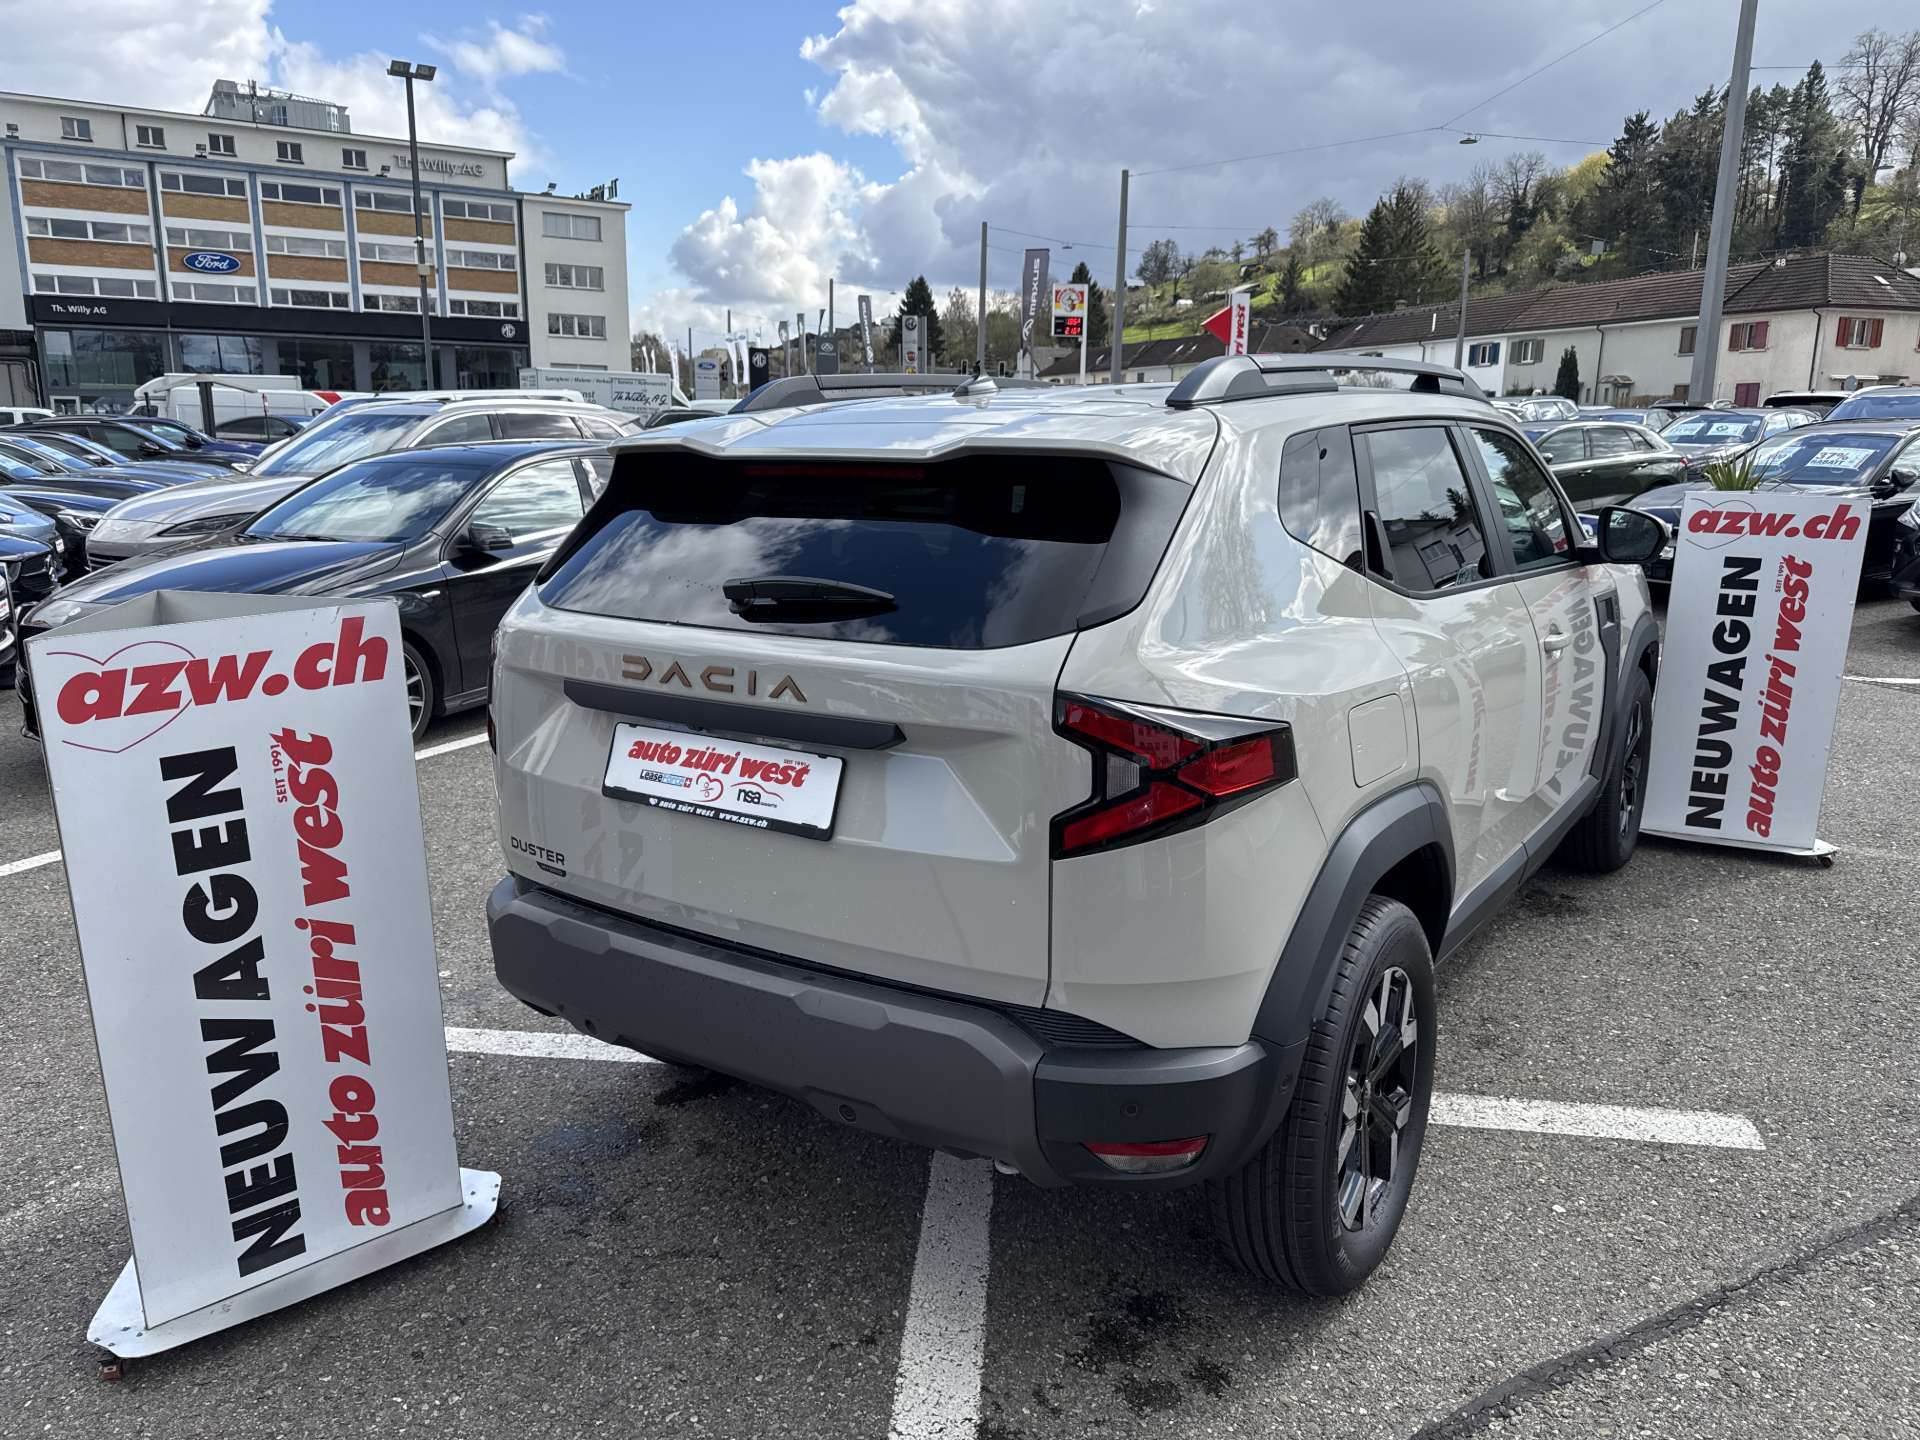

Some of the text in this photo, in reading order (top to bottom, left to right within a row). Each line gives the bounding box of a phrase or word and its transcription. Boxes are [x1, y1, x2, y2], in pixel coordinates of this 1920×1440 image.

[421, 158, 457, 177] Willy
[462, 162, 484, 177] AG
[195, 254, 230, 270] Ford
[67, 304, 91, 316] Willy
[93, 306, 108, 315] AG
[1028, 258, 1041, 317] MAXUS
[1688, 504, 1861, 540] azw.ch
[57, 616, 389, 725] azw.ch
[622, 654, 808, 704] DACIA
[1685, 556, 1762, 829] NEUWAGEN
[1746, 554, 1812, 838] auto züri west
[270, 744, 288, 804] SEIT 1991
[628, 739, 811, 788] auto züri west
[737, 788, 761, 805] nsa
[511, 836, 565, 866] DUSTER
[270, 727, 391, 1227] auto züri west
[159, 746, 307, 1278] NEUWAGEN
